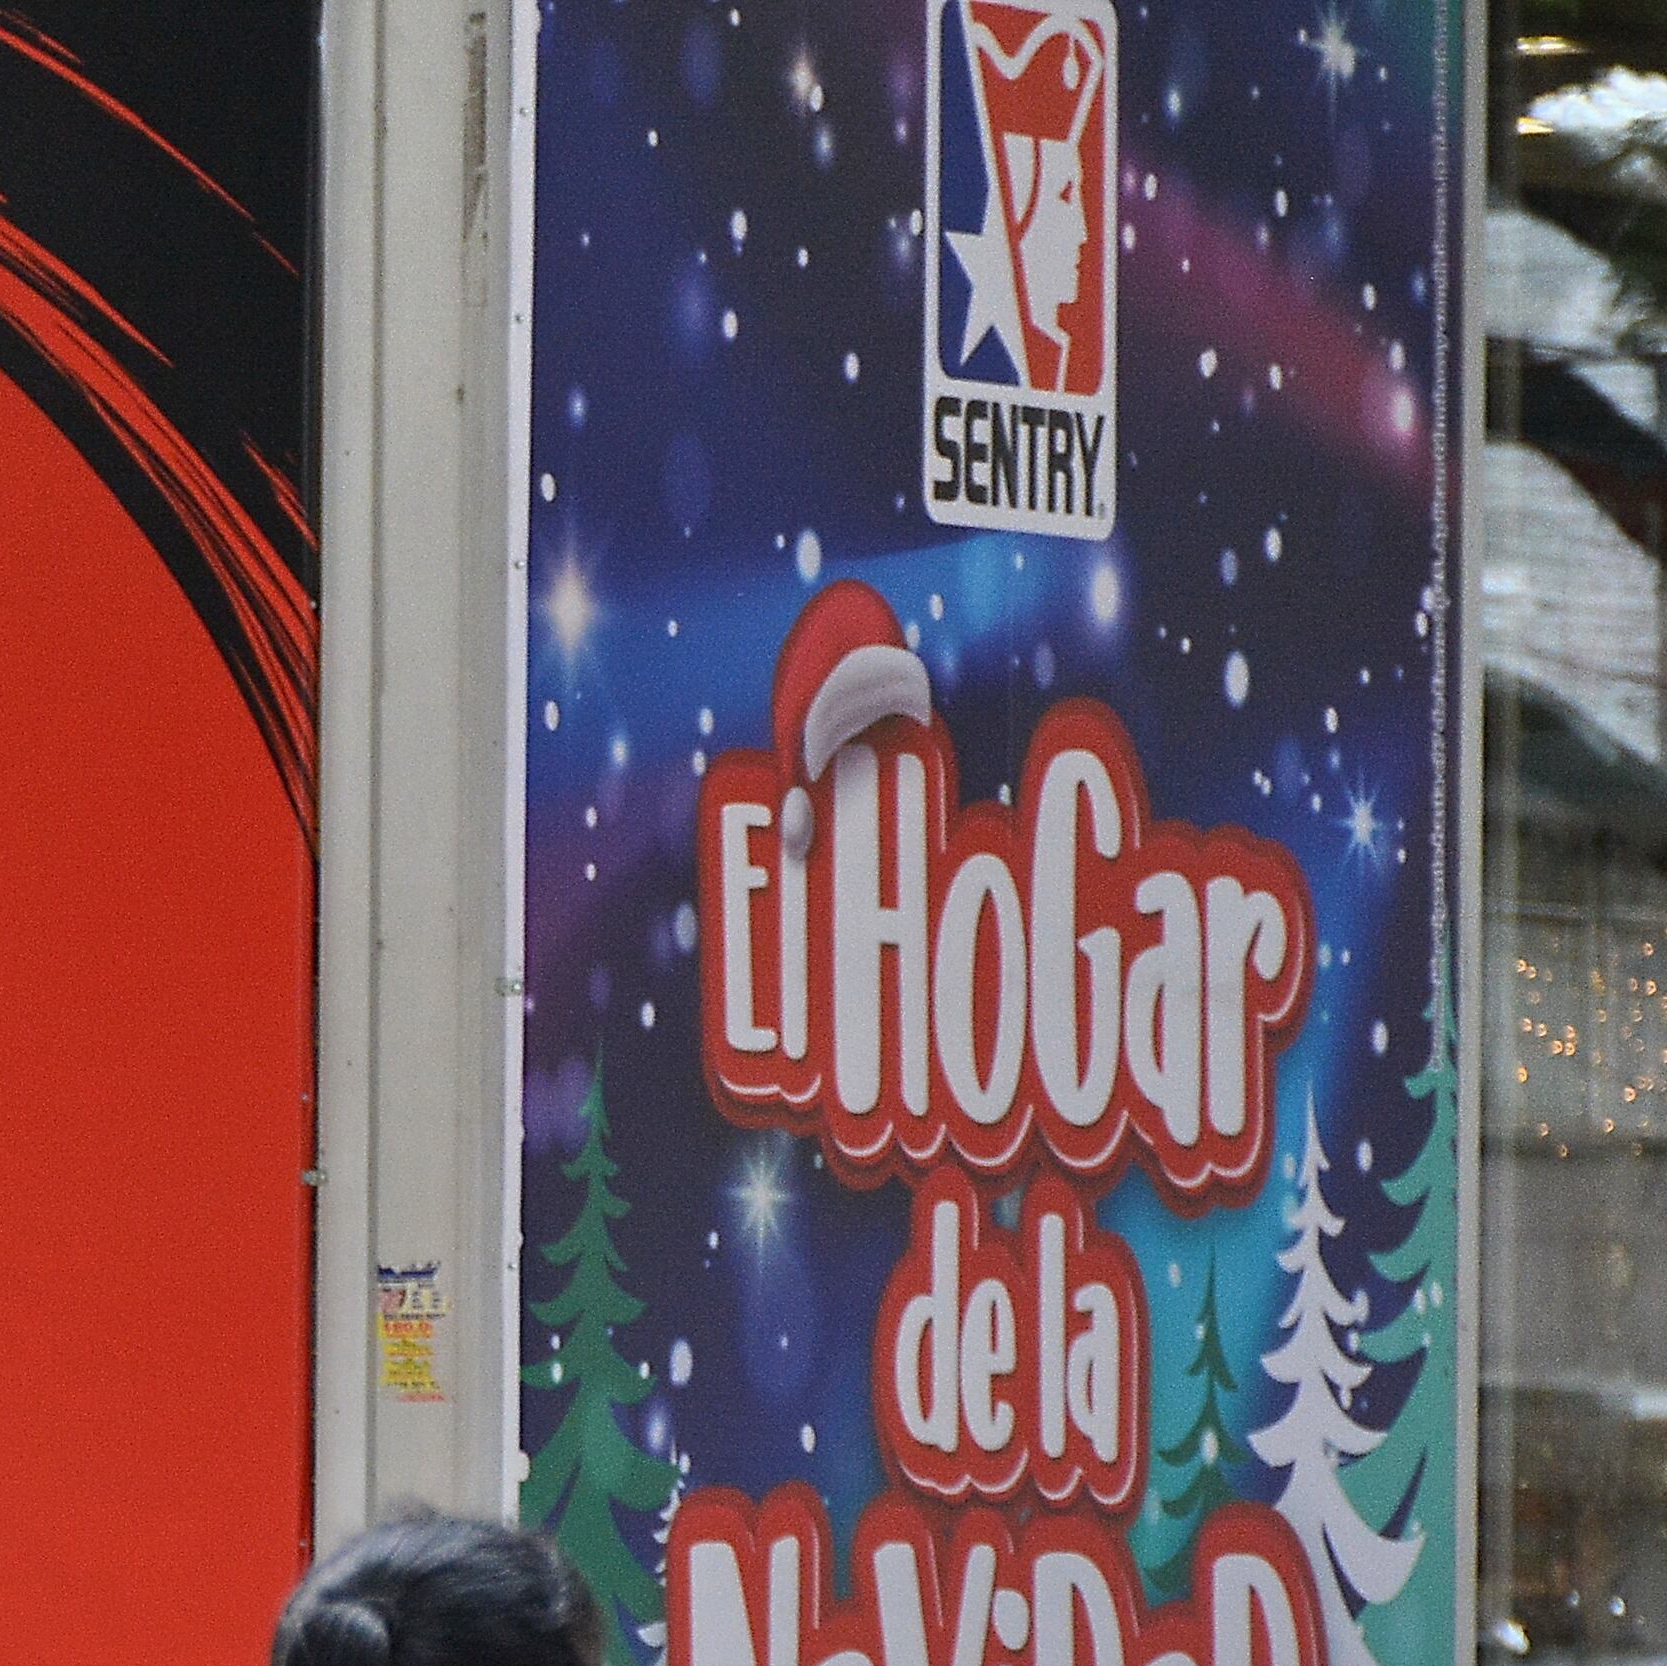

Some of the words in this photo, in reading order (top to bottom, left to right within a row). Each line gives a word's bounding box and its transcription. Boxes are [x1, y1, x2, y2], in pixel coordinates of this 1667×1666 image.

[932, 396, 1105, 519] SENTRY
[895, 1200, 1017, 1453] de
[1039, 1212, 1119, 1464] la
